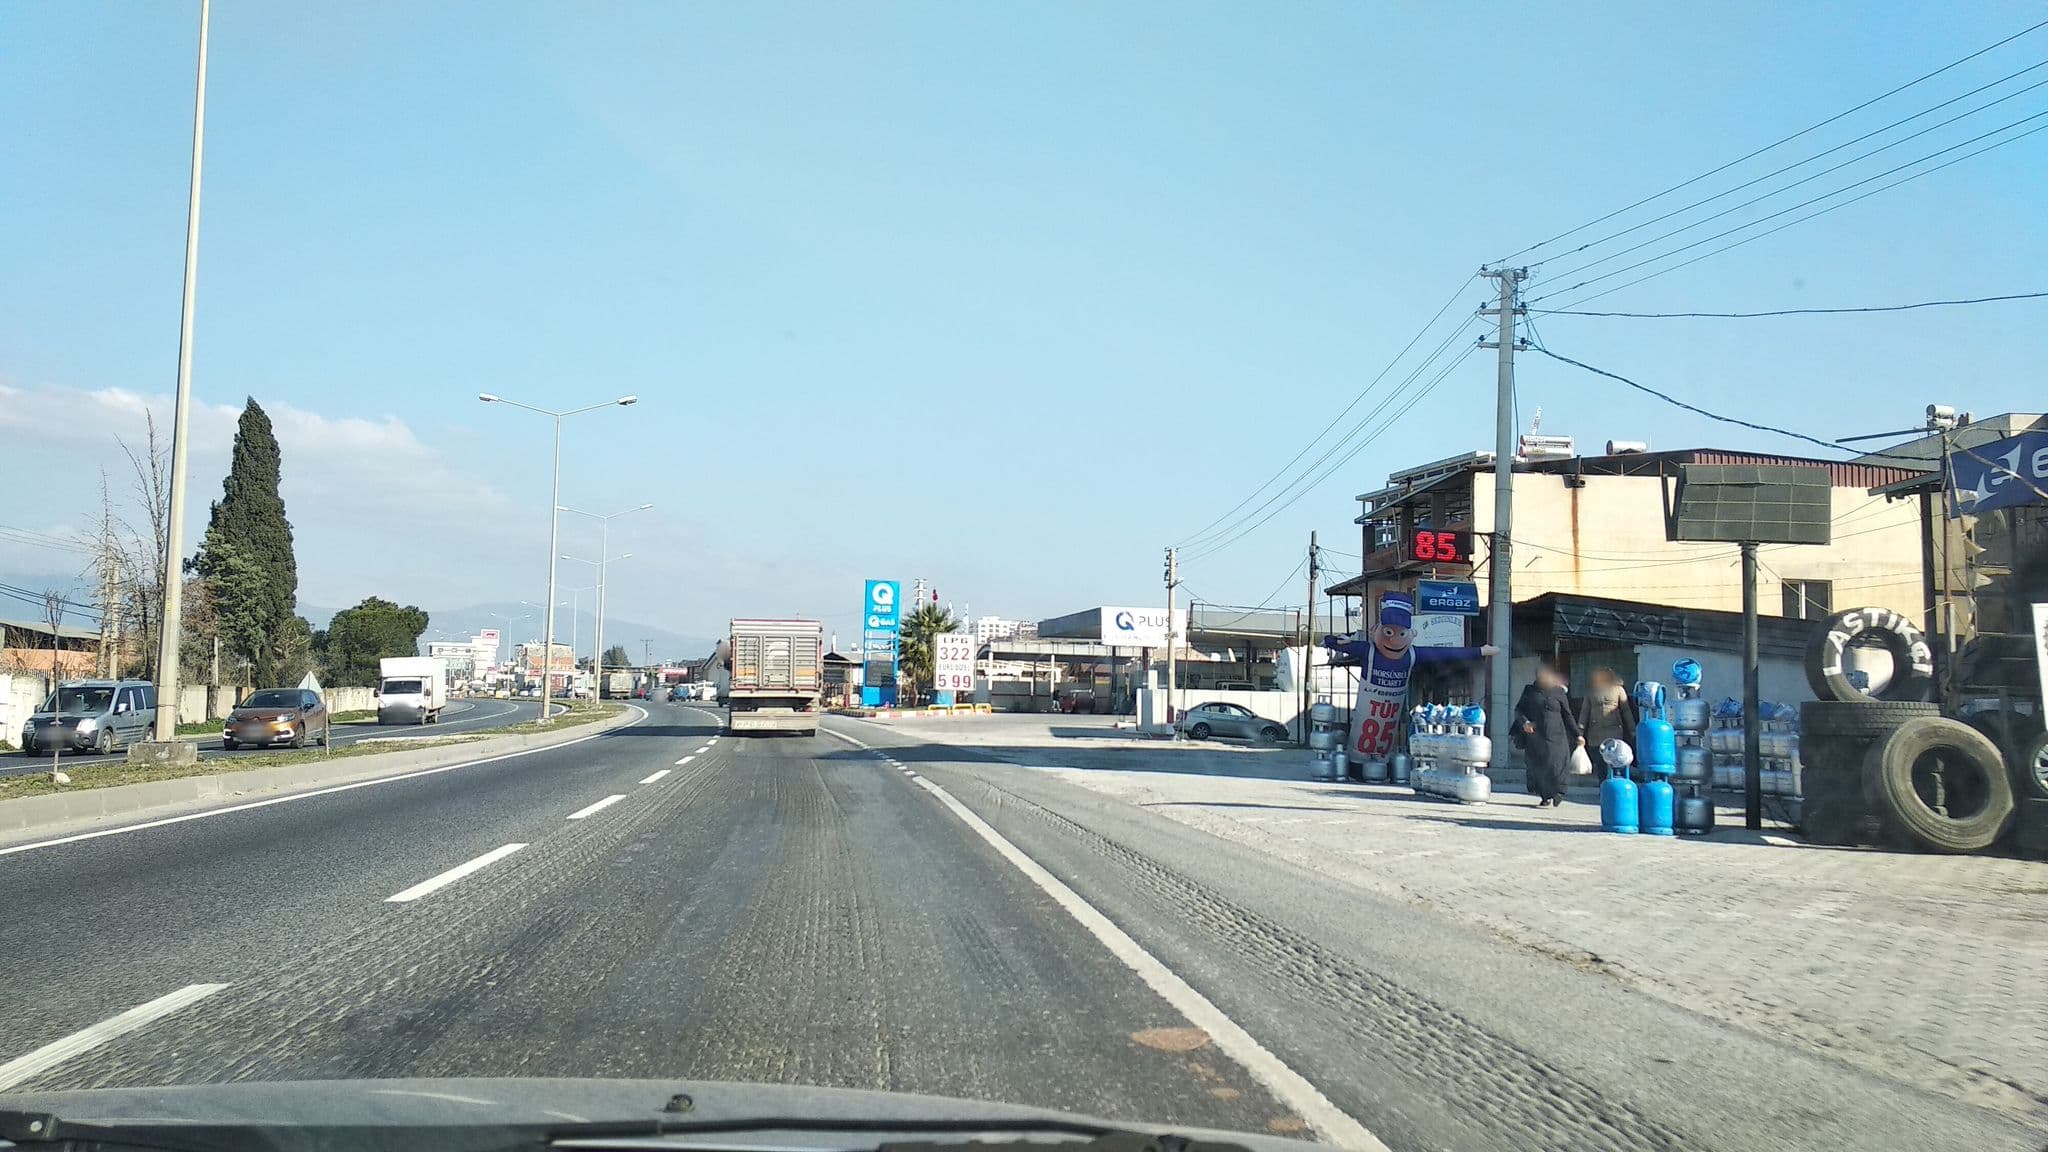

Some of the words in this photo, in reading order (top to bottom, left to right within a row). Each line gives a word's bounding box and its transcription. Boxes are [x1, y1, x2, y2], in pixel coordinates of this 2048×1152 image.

[1415, 530, 1457, 562] 85
[943, 636, 968, 645] LPG
[1369, 699, 1400, 718] TÜP
[1357, 718, 1397, 758] 85
